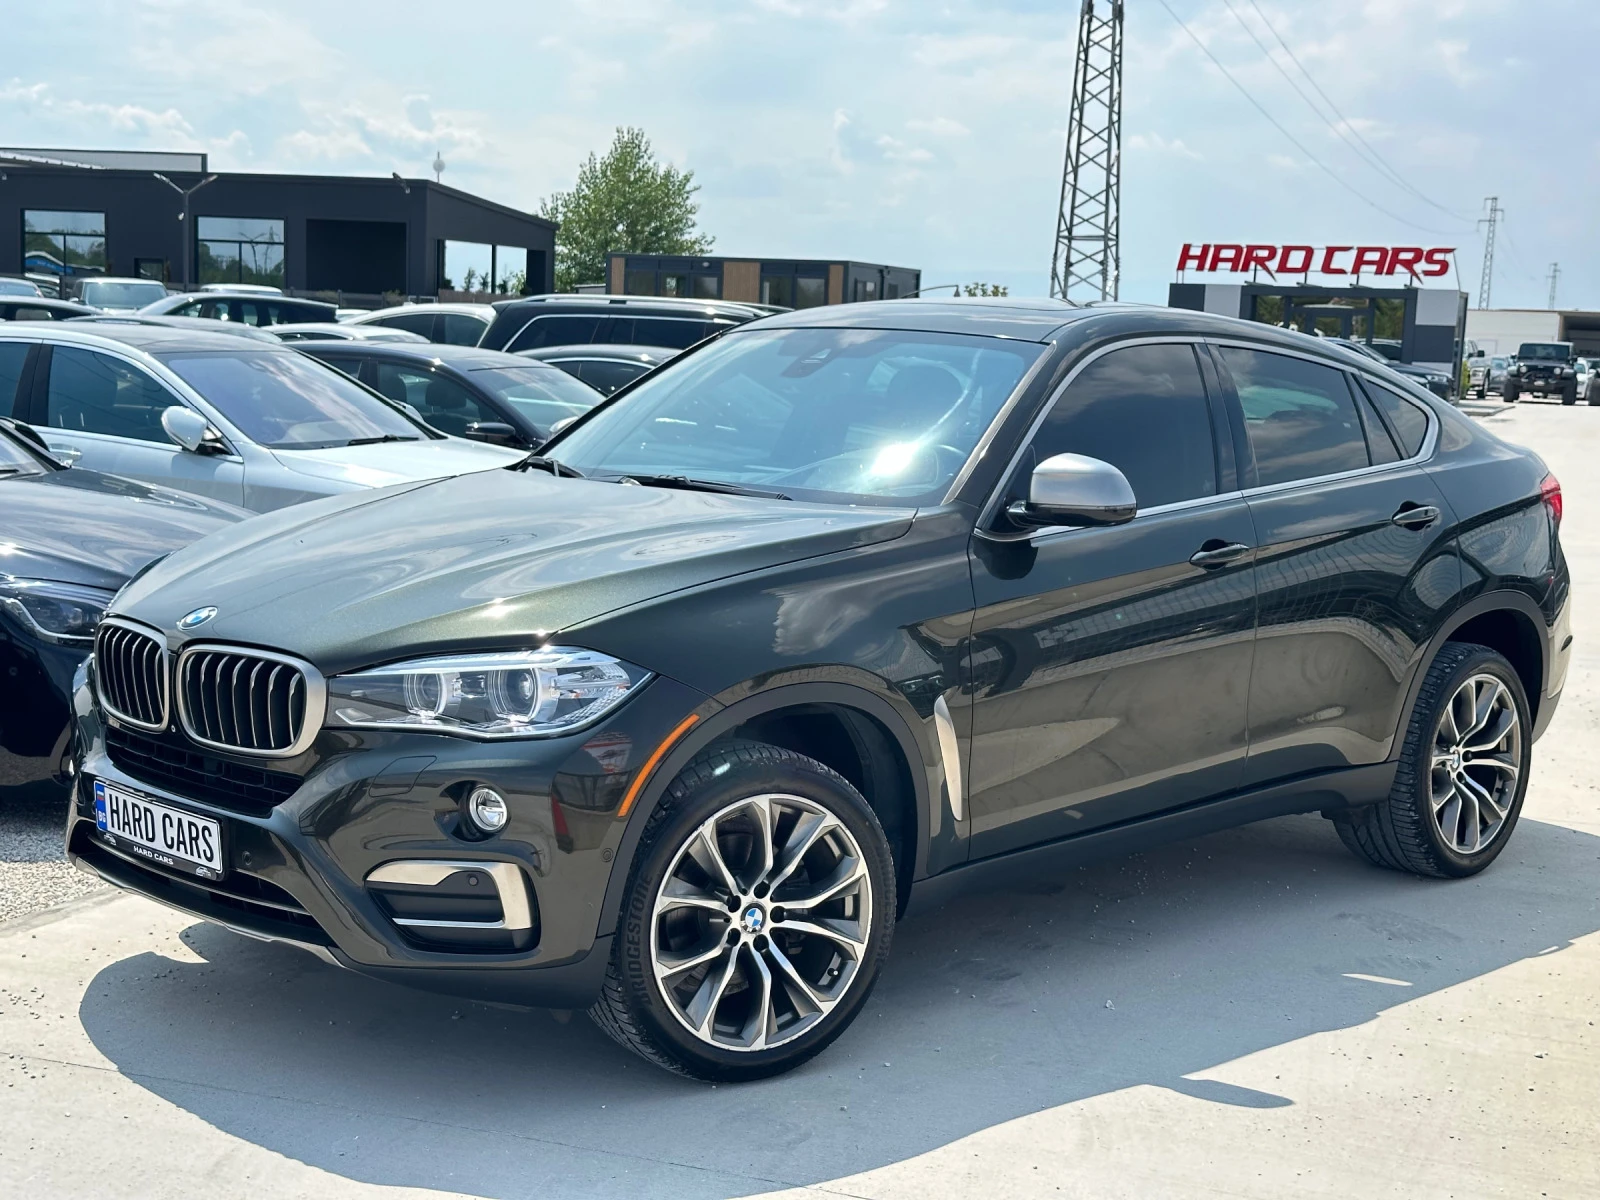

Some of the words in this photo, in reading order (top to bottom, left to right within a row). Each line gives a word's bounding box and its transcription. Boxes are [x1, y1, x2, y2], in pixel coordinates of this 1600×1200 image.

[1177, 243, 1314, 282] HARD
[1321, 246, 1457, 285] CARS
[109, 794, 156, 842] HARD
[162, 813, 214, 862] CARS
[133, 845, 153, 858] HARD
[154, 853, 174, 865] CARS
